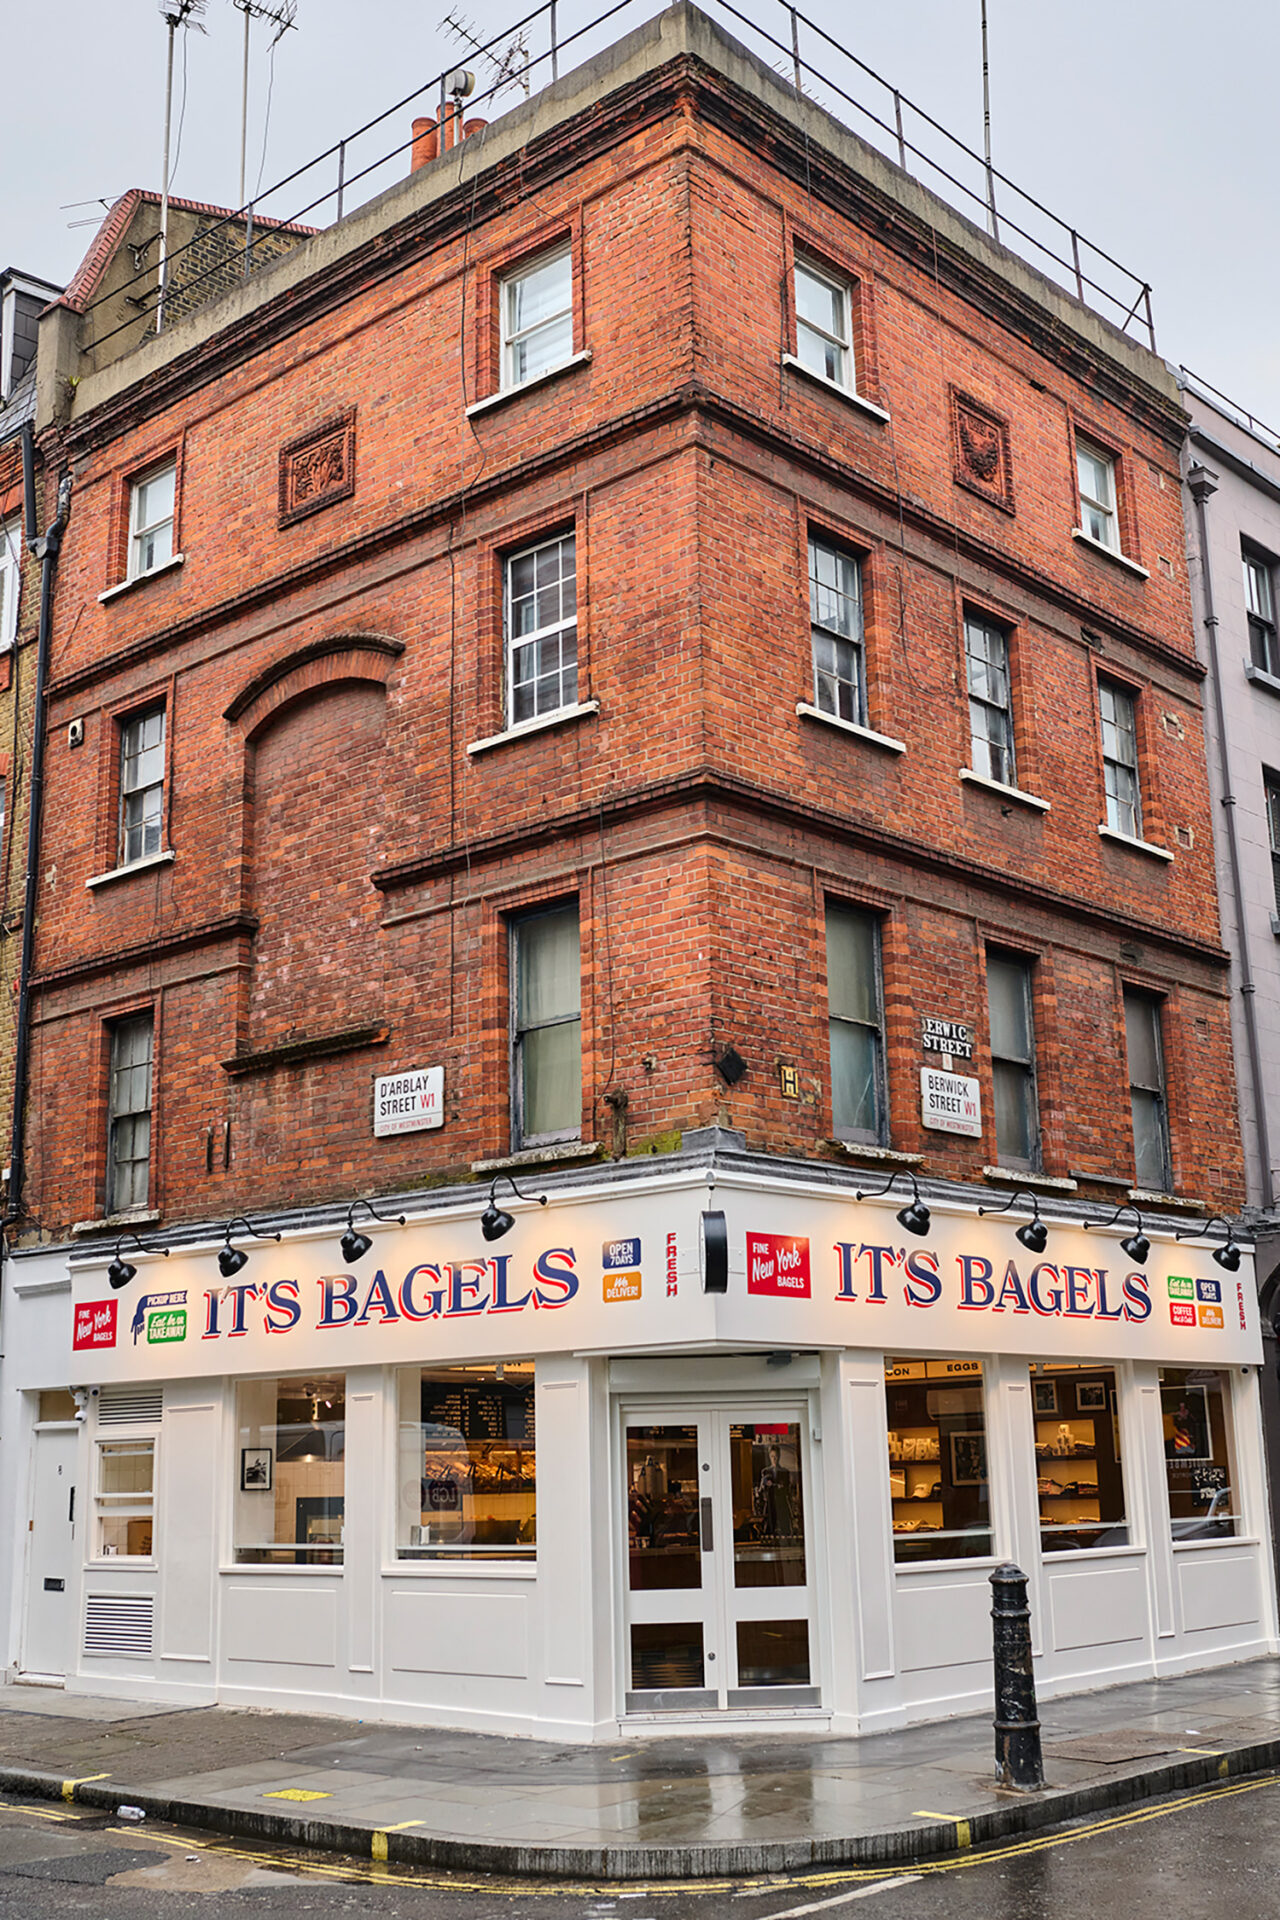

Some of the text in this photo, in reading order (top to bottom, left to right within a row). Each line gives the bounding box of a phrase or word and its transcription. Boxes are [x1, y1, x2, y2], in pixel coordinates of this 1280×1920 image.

[923, 1033, 972, 1058] STREET
[380, 1075, 429, 1098] D'ARBLAY
[928, 1075, 969, 1097] BERWICK
[380, 1093, 435, 1116] STREET W1
[929, 1094, 977, 1117] STREET W1
[609, 1242, 634, 1256] OPEN
[752, 1242, 769, 1255] FINE
[666, 1232, 678, 1297] FRESH
[752, 1242, 801, 1283] New York
[777, 1275, 805, 1289] BAGELS
[832, 1241, 1152, 1324] IT'S BAGELS
[1200, 1282, 1216, 1293] OPEN
[147, 1292, 186, 1306] PICKUP HERE
[201, 1247, 580, 1340] IT'S BAGELS
[606, 1285, 639, 1299] DELIVER!
[1172, 1306, 1193, 1316] COFFEE
[1236, 1282, 1247, 1331] FRESH
[78, 1310, 90, 1319] FINE
[151, 1314, 167, 1328] Eat
[76, 1304, 112, 1342] New York
[93, 1331, 113, 1342] BAGELS
[149, 1325, 186, 1340] TAKEAWAY
[946, 1362, 979, 1372] EGGS
